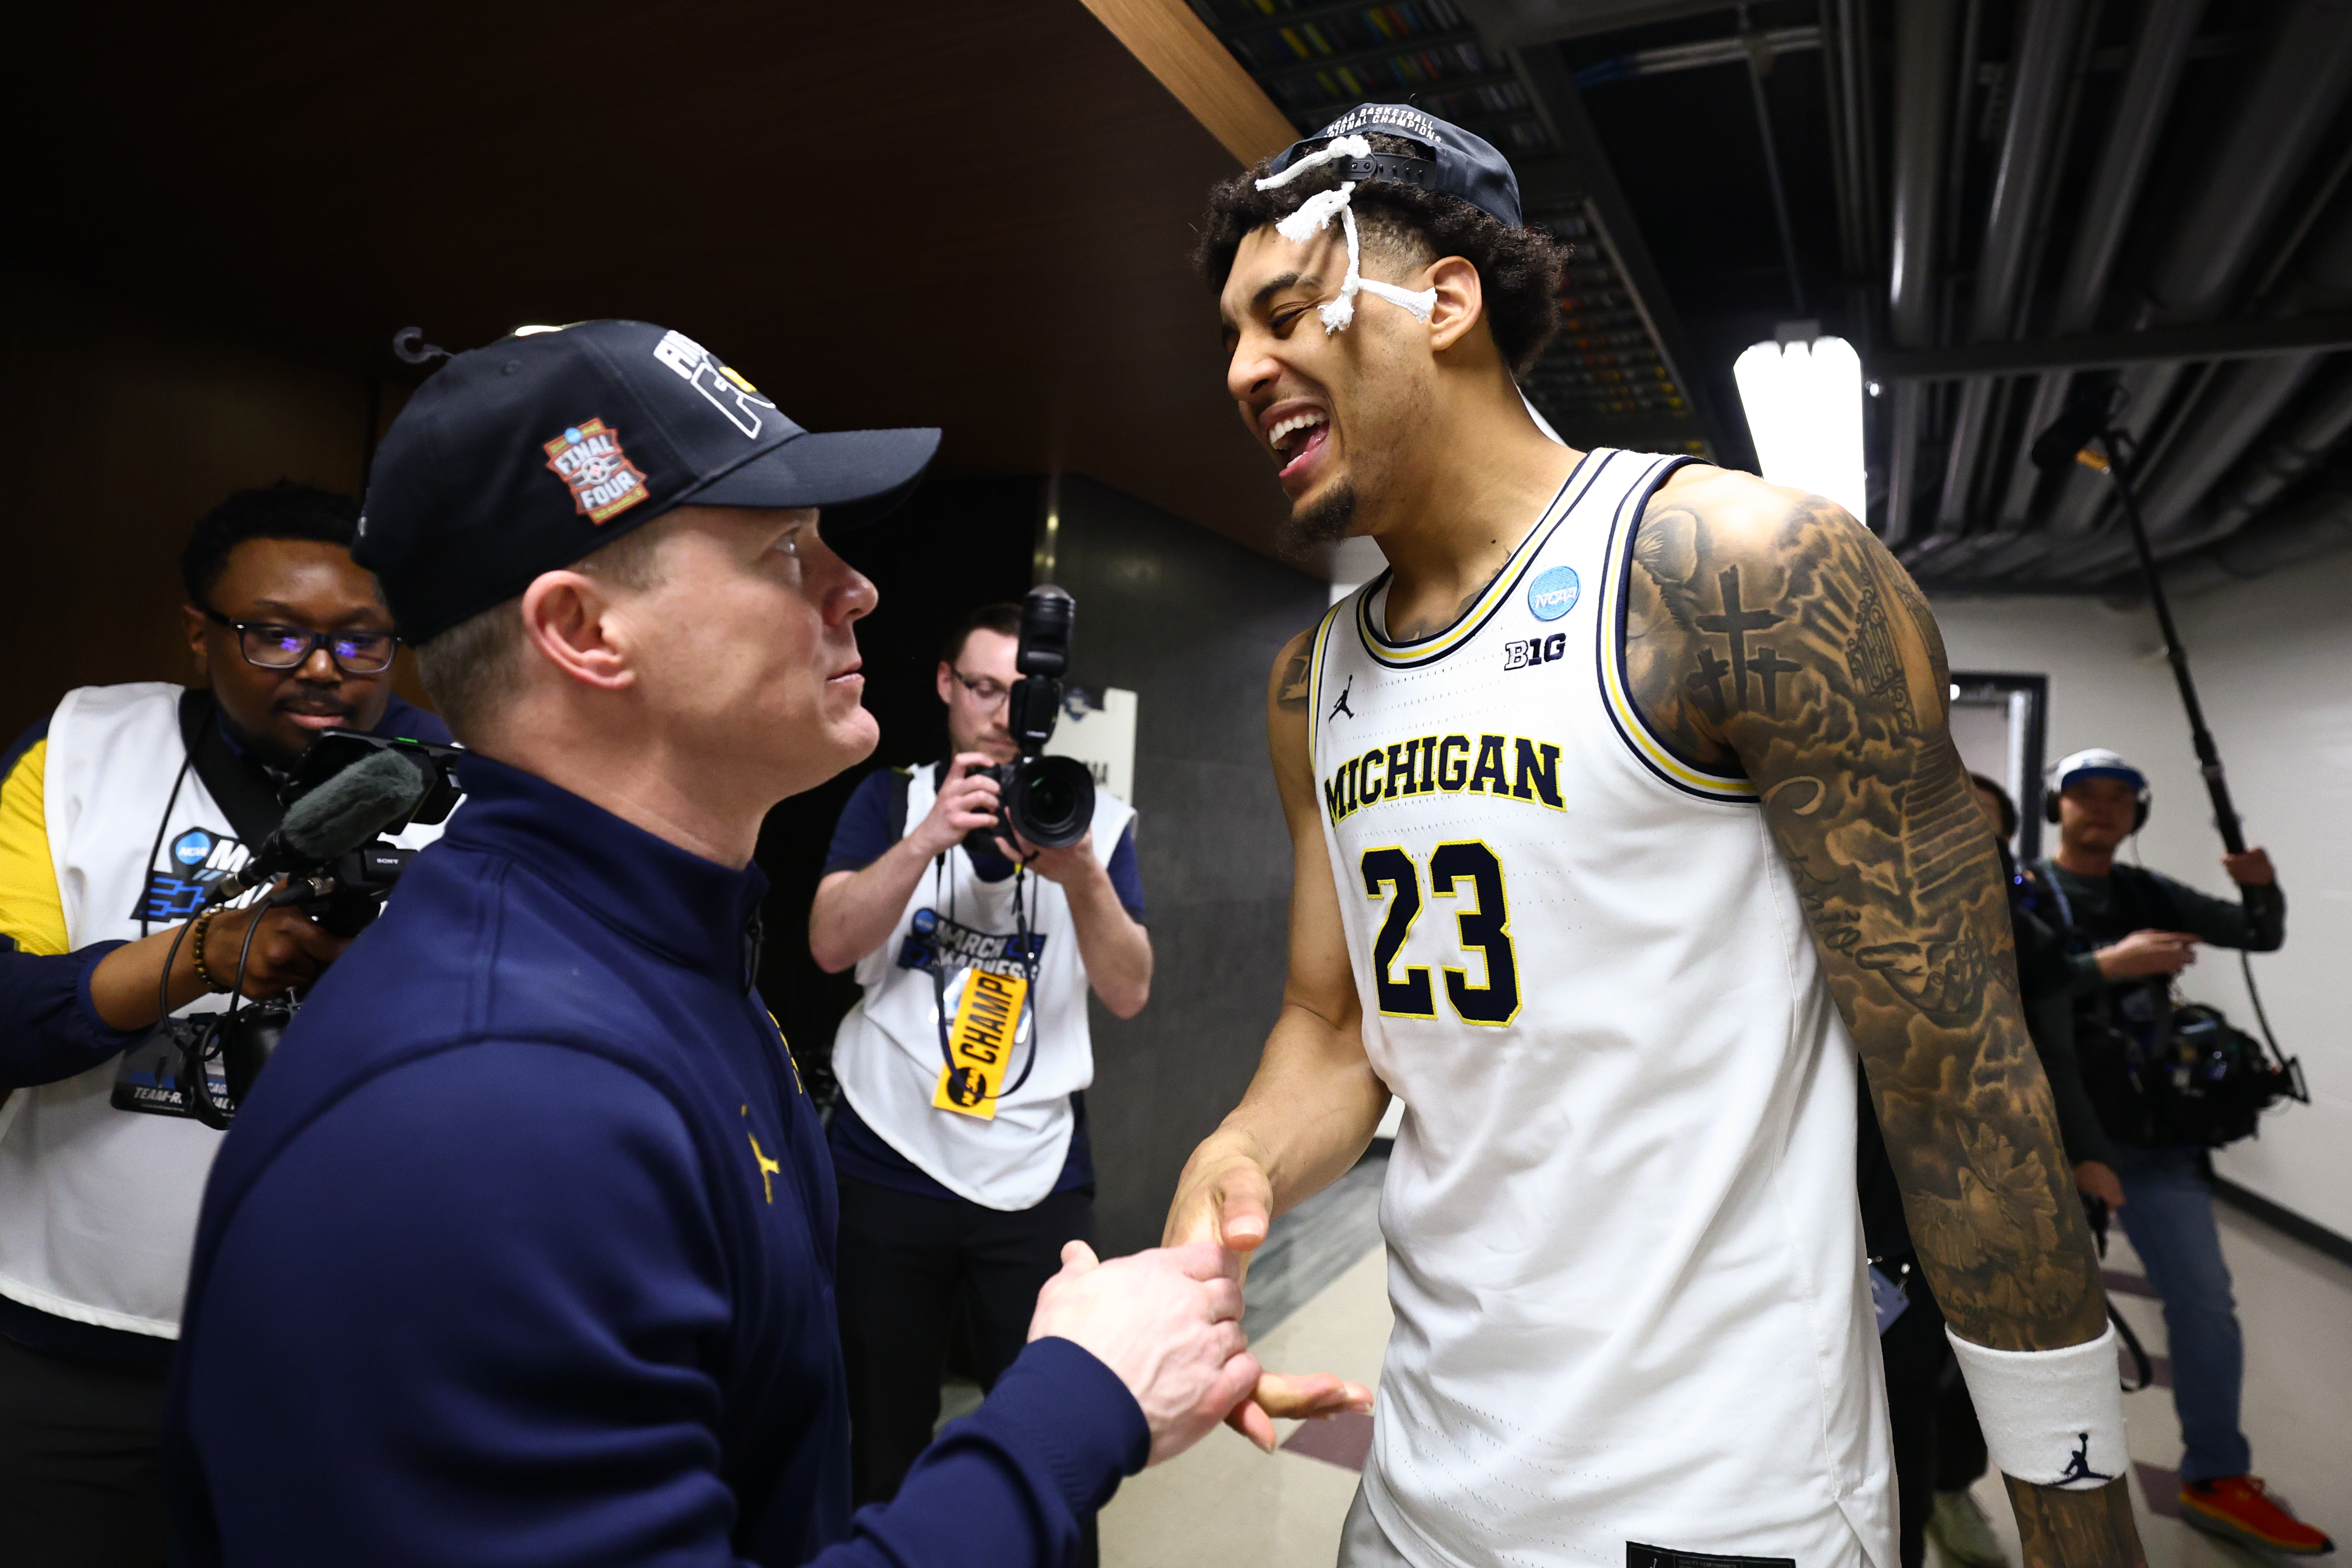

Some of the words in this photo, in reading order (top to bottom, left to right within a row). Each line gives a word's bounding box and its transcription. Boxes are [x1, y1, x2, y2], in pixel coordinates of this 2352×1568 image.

[1360, 107, 1434, 130] BASKETBALL
[1371, 115, 1442, 143] CHAMPIONS
[554, 434, 616, 475] FINAL
[581, 470, 636, 510] FOUR
[1535, 586, 1578, 609] NCAA
[1324, 733, 1567, 830] MICHIGAN
[1361, 838, 1522, 1027] 23
